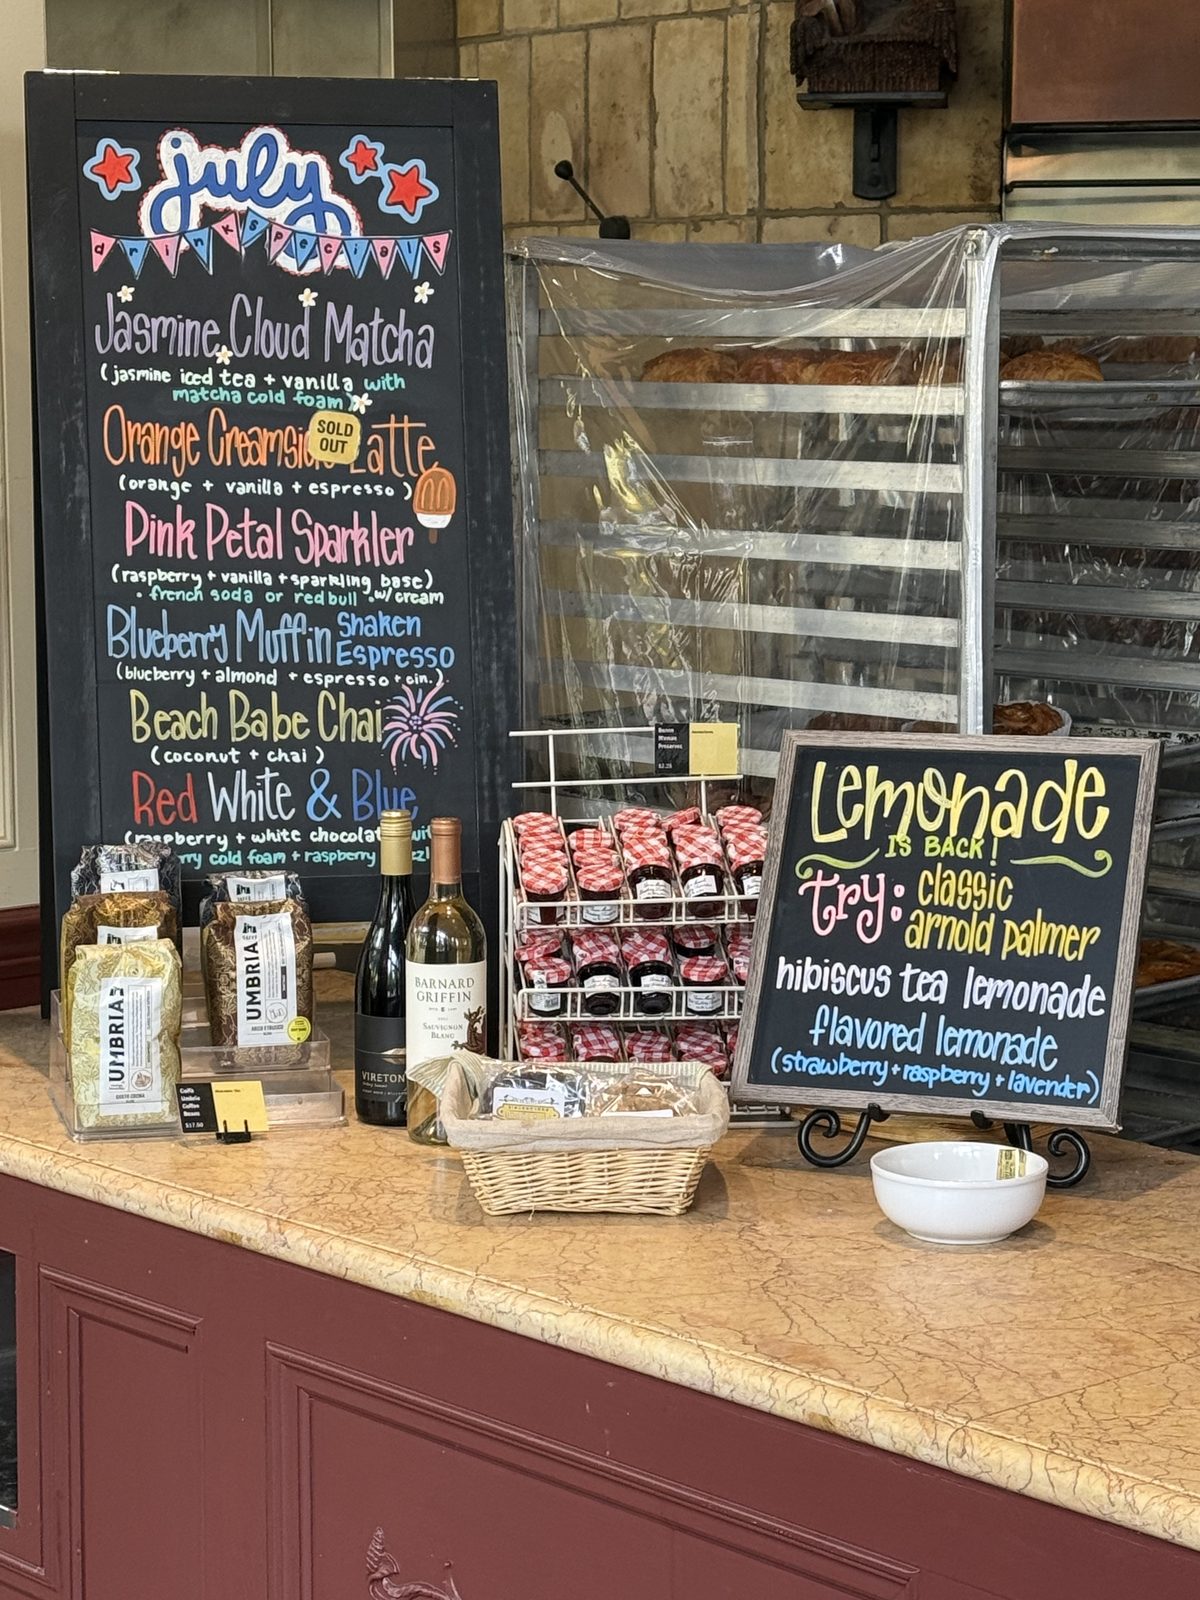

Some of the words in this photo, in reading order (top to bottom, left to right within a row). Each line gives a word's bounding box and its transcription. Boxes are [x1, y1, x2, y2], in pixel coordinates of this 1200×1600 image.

[150, 132, 351, 260] july
[249, 218, 442, 258] specials
[95, 293, 220, 358] Jasmine
[230, 292, 310, 359] Cloud
[324, 301, 434, 369] Matcha
[172, 386, 242, 404] matcha
[246, 388, 285, 405] cold
[180, 366, 213, 386] iced
[219, 368, 256, 388] tea
[263, 374, 276, 386] +
[282, 372, 353, 393] vanilla
[363, 374, 406, 392] with
[103, 404, 200, 478] Orange
[208, 406, 335, 470] Creamsic
[316, 419, 354, 437] SOLD
[319, 437, 348, 454] OUT
[118, 474, 192, 500] (orange
[202, 479, 214, 491] +
[226, 478, 283, 496] vanilla
[291, 481, 302, 494] +
[125, 500, 198, 561] Pink
[205, 502, 284, 561] Petal
[291, 508, 414, 567] Sparkler
[111, 563, 202, 589] (raspberry
[220, 569, 272, 586] vanilla
[289, 573, 372, 595] sparkling
[380, 568, 433, 590] base)
[149, 584, 203, 602] french
[210, 587, 254, 604] soda
[265, 591, 284, 603] or
[107, 603, 229, 664] Blueberry
[236, 608, 332, 665] Muffin
[337, 609, 421, 638] Shaken
[336, 640, 455, 671] Espresso
[116, 661, 195, 688] (blueberry
[201, 668, 211, 680] +
[215, 666, 277, 686] almond
[288, 671, 298, 681] +
[303, 671, 389, 689] espresso
[129, 688, 218, 744] Beach
[228, 688, 310, 744] Babe
[317, 690, 383, 743] Chai
[250, 751, 259, 761] +
[131, 769, 199, 828] Red
[207, 766, 296, 823] White
[306, 768, 342, 823] &
[352, 768, 419, 821] Blue
[811, 759, 1110, 844] Lemonade
[235, 834, 245, 845] +
[251, 828, 301, 845] white
[310, 826, 382, 844] chocolat
[884, 835, 911, 858] IS
[209, 849, 242, 865] cold
[247, 850, 286, 865] foam
[291, 852, 301, 863] +
[304, 850, 377, 867] raspberry
[917, 862, 1014, 912] classic
[798, 869, 905, 944] try:
[904, 908, 996, 958] arnold
[1001, 908, 1101, 962] palmer
[244, 942, 261, 1021] UMBRIA
[415, 976, 475, 989] BARNARD
[416, 991, 472, 1003] GRIFFIN
[775, 956, 892, 998] hibiscus
[901, 962, 949, 1005] tea
[963, 965, 1106, 1021] lemonade
[108, 1000, 125, 1082] UMBRIA
[809, 1004, 927, 1055] flavored
[935, 1013, 1058, 1072] lemonade
[361, 1070, 405, 1083] VIRETON
[903, 1062, 990, 1096] raspberry
[1007, 1069, 1101, 1105] lavender)
